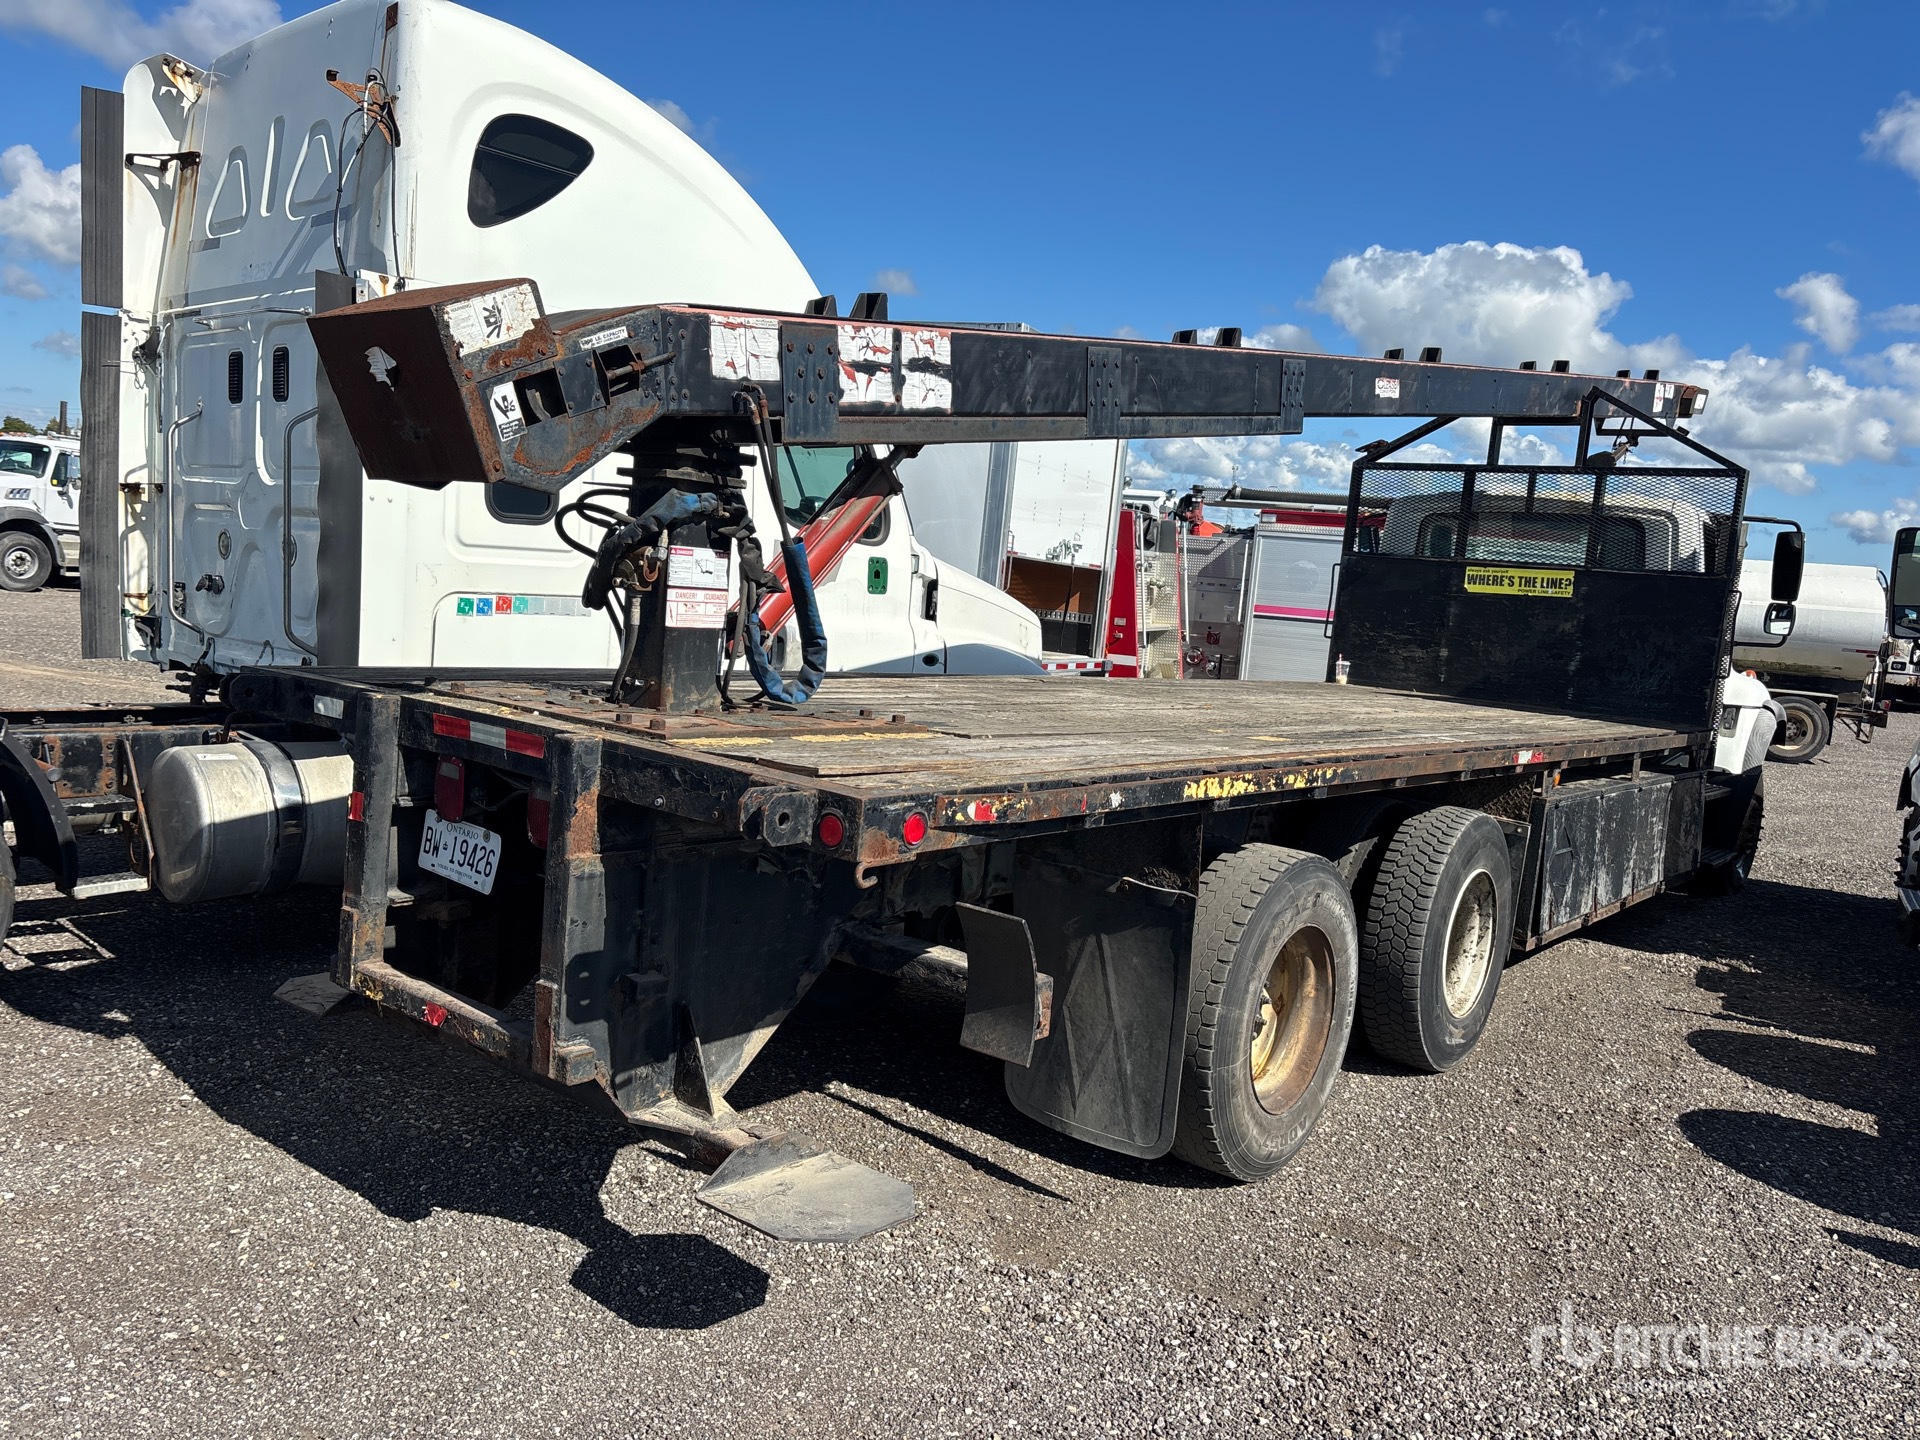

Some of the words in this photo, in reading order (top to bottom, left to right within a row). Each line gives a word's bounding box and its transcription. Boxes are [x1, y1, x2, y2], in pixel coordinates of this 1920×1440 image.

[603, 329, 625, 339] CAPACITY
[1467, 573, 1515, 588] WHERE'S
[1518, 576, 1538, 588] THE
[1540, 576, 1572, 590] LINE?
[674, 591, 698, 600] DANGER!
[423, 825, 443, 859] BW
[448, 836, 496, 878] 19426
